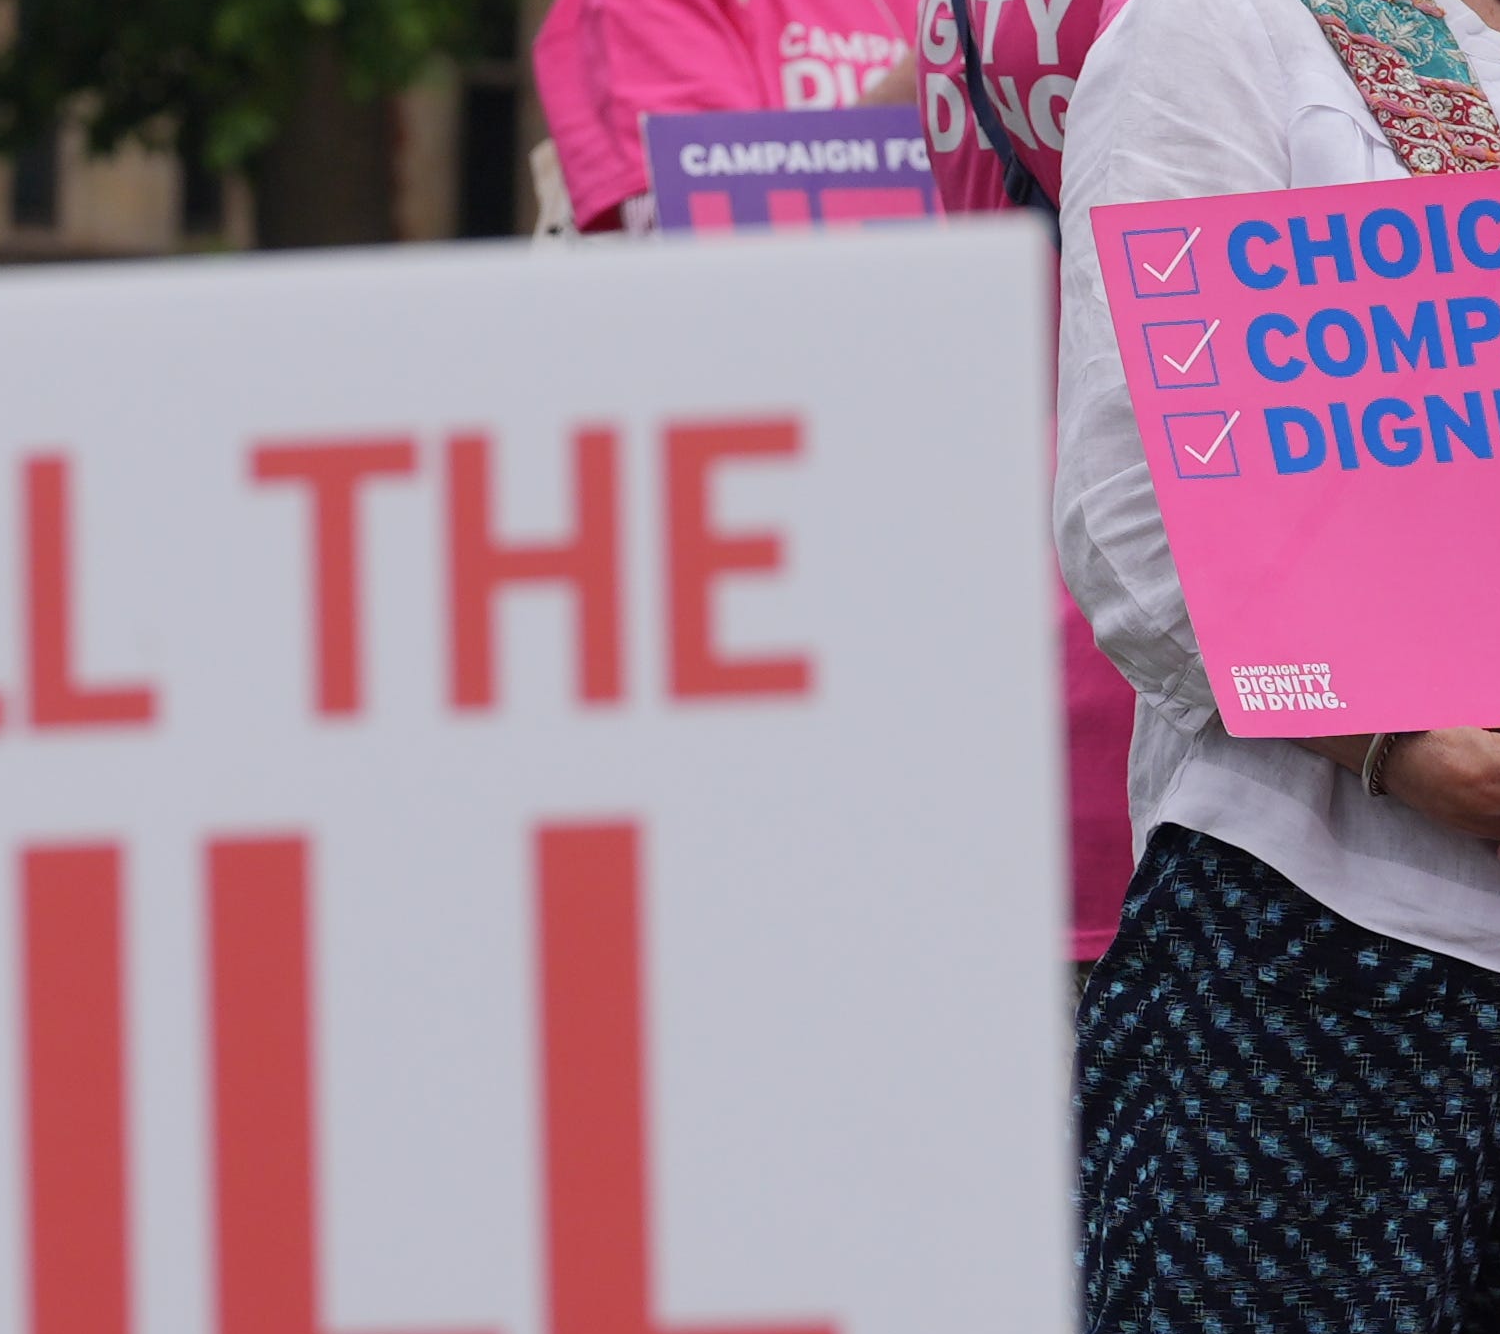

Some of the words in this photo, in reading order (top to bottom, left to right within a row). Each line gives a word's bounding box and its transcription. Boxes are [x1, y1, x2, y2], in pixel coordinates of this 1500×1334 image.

[680, 139, 879, 177] CAMPAIGN
[253, 421, 809, 715] THE
[1230, 664, 1300, 676] CAMPAIGN
[1302, 663, 1331, 674] FOR
[1233, 673, 1331, 694] DIGNITY
[1239, 692, 1266, 711] IN
[1266, 691, 1347, 710] DYING.
